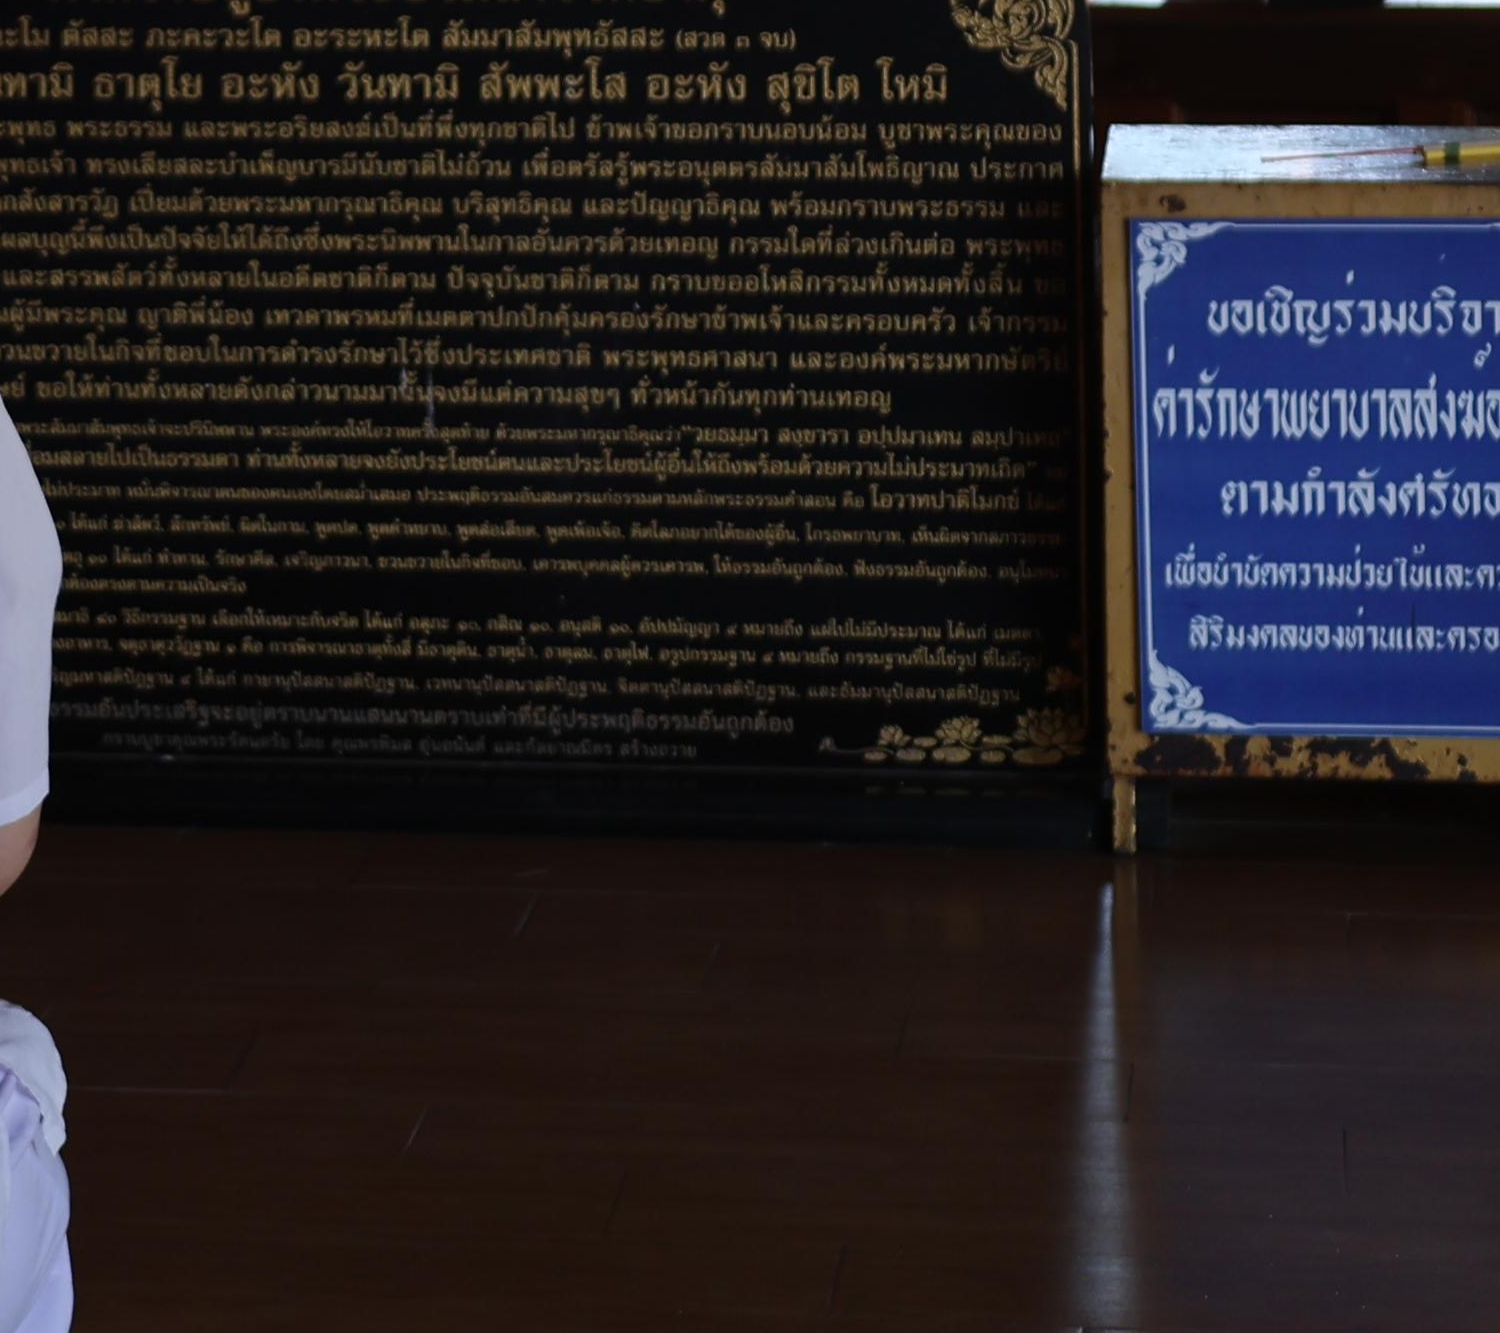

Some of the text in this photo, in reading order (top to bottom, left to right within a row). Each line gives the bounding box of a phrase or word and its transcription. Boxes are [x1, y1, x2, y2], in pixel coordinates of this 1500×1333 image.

[62, 18, 133, 49] ตัสสะ
[145, 14, 282, 49] ภะคะวะโต
[293, 14, 430, 50] อะระหะโต
[442, 18, 664, 60] สัมมาสัมพุทธัสสะ
[675, 29, 726, 51] (สวด
[759, 28, 798, 51] จบ)
[94, 55, 203, 112] ธาตุโย
[221, 60, 320, 102] อะหัง
[337, 60, 459, 101] วันทามิ
[479, 57, 627, 102] สัพพะโส
[647, 60, 747, 102] อะหัง
[768, 57, 862, 113] สุขิโต
[876, 57, 950, 103] โหมิ
[67, 117, 173, 140] พระธรรม
[585, 111, 867, 143] ข้าพเจ้าขอกราบนอบน้อม
[878, 121, 1063, 151] บูชาพระคุณของ
[970, 155, 1065, 182] ประกาศ
[137, 296, 254, 332] ญาติพี่น้อง
[603, 346, 779, 376] พระพุทธศาสนา
